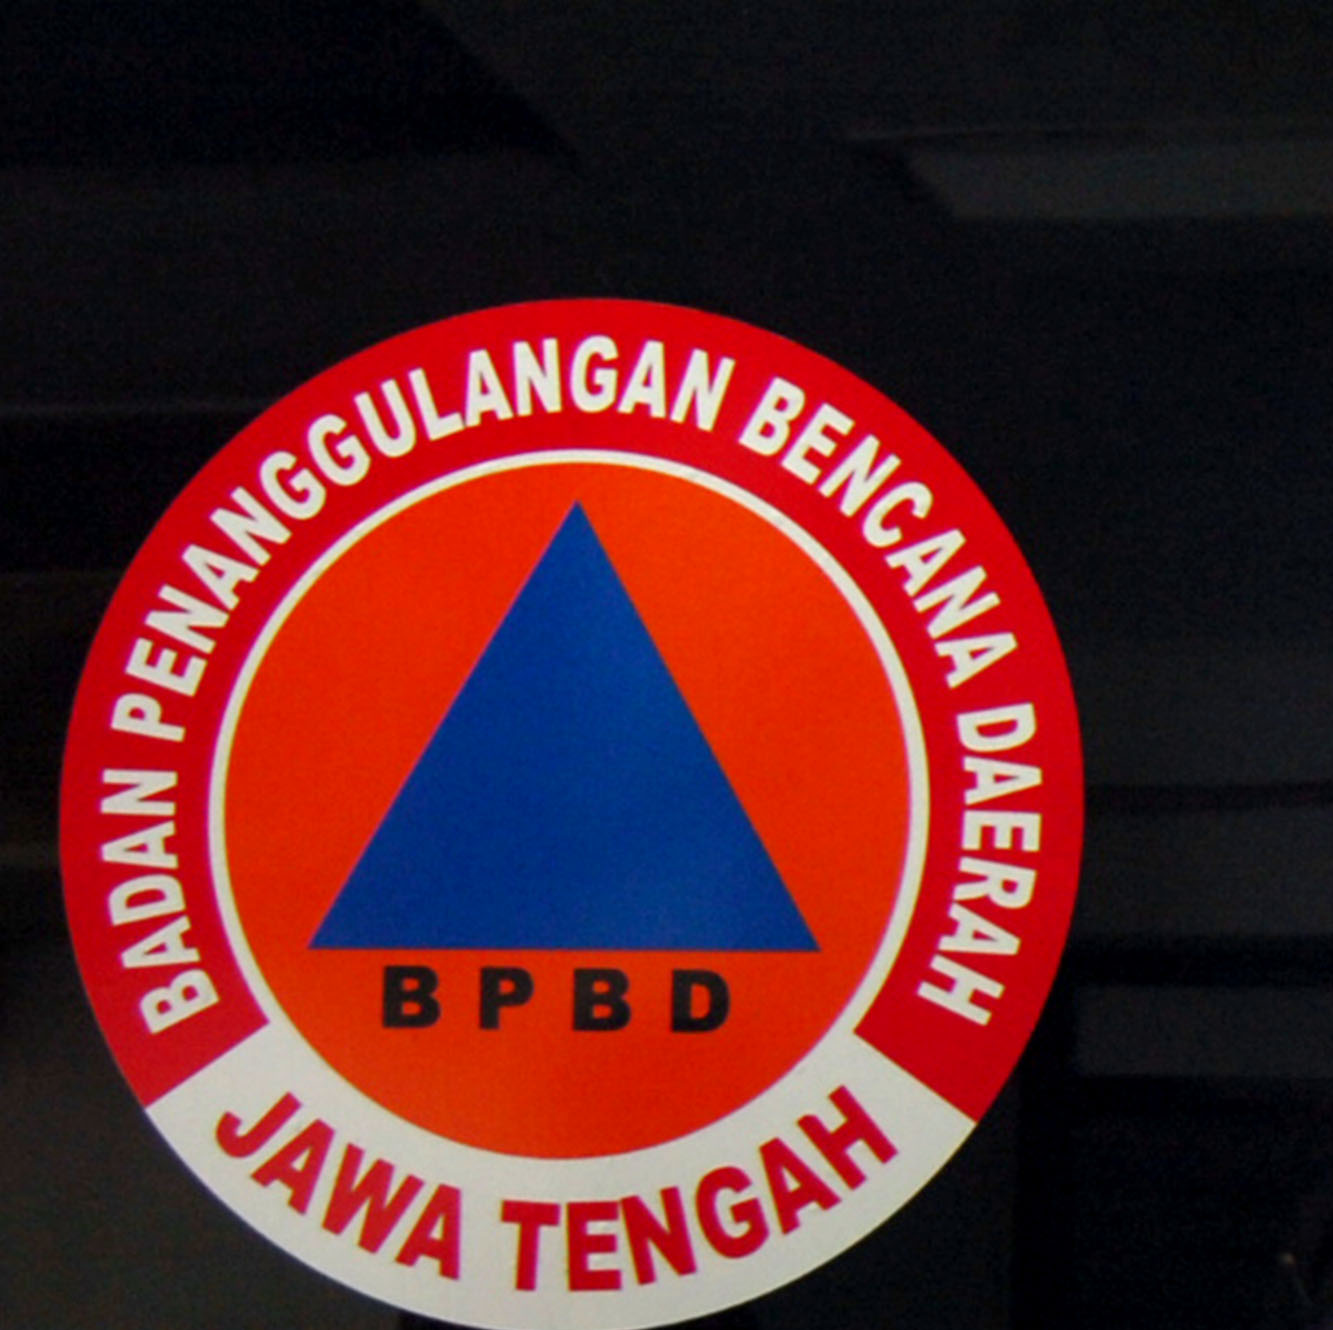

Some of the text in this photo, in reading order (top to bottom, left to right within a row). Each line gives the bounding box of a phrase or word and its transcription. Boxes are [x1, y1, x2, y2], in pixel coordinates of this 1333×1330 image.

[99, 334, 1043, 1035] BADAN PENANGGULANGAN BENCANA DAERAH
[216, 1084, 899, 1293] JAWA TENGAH
